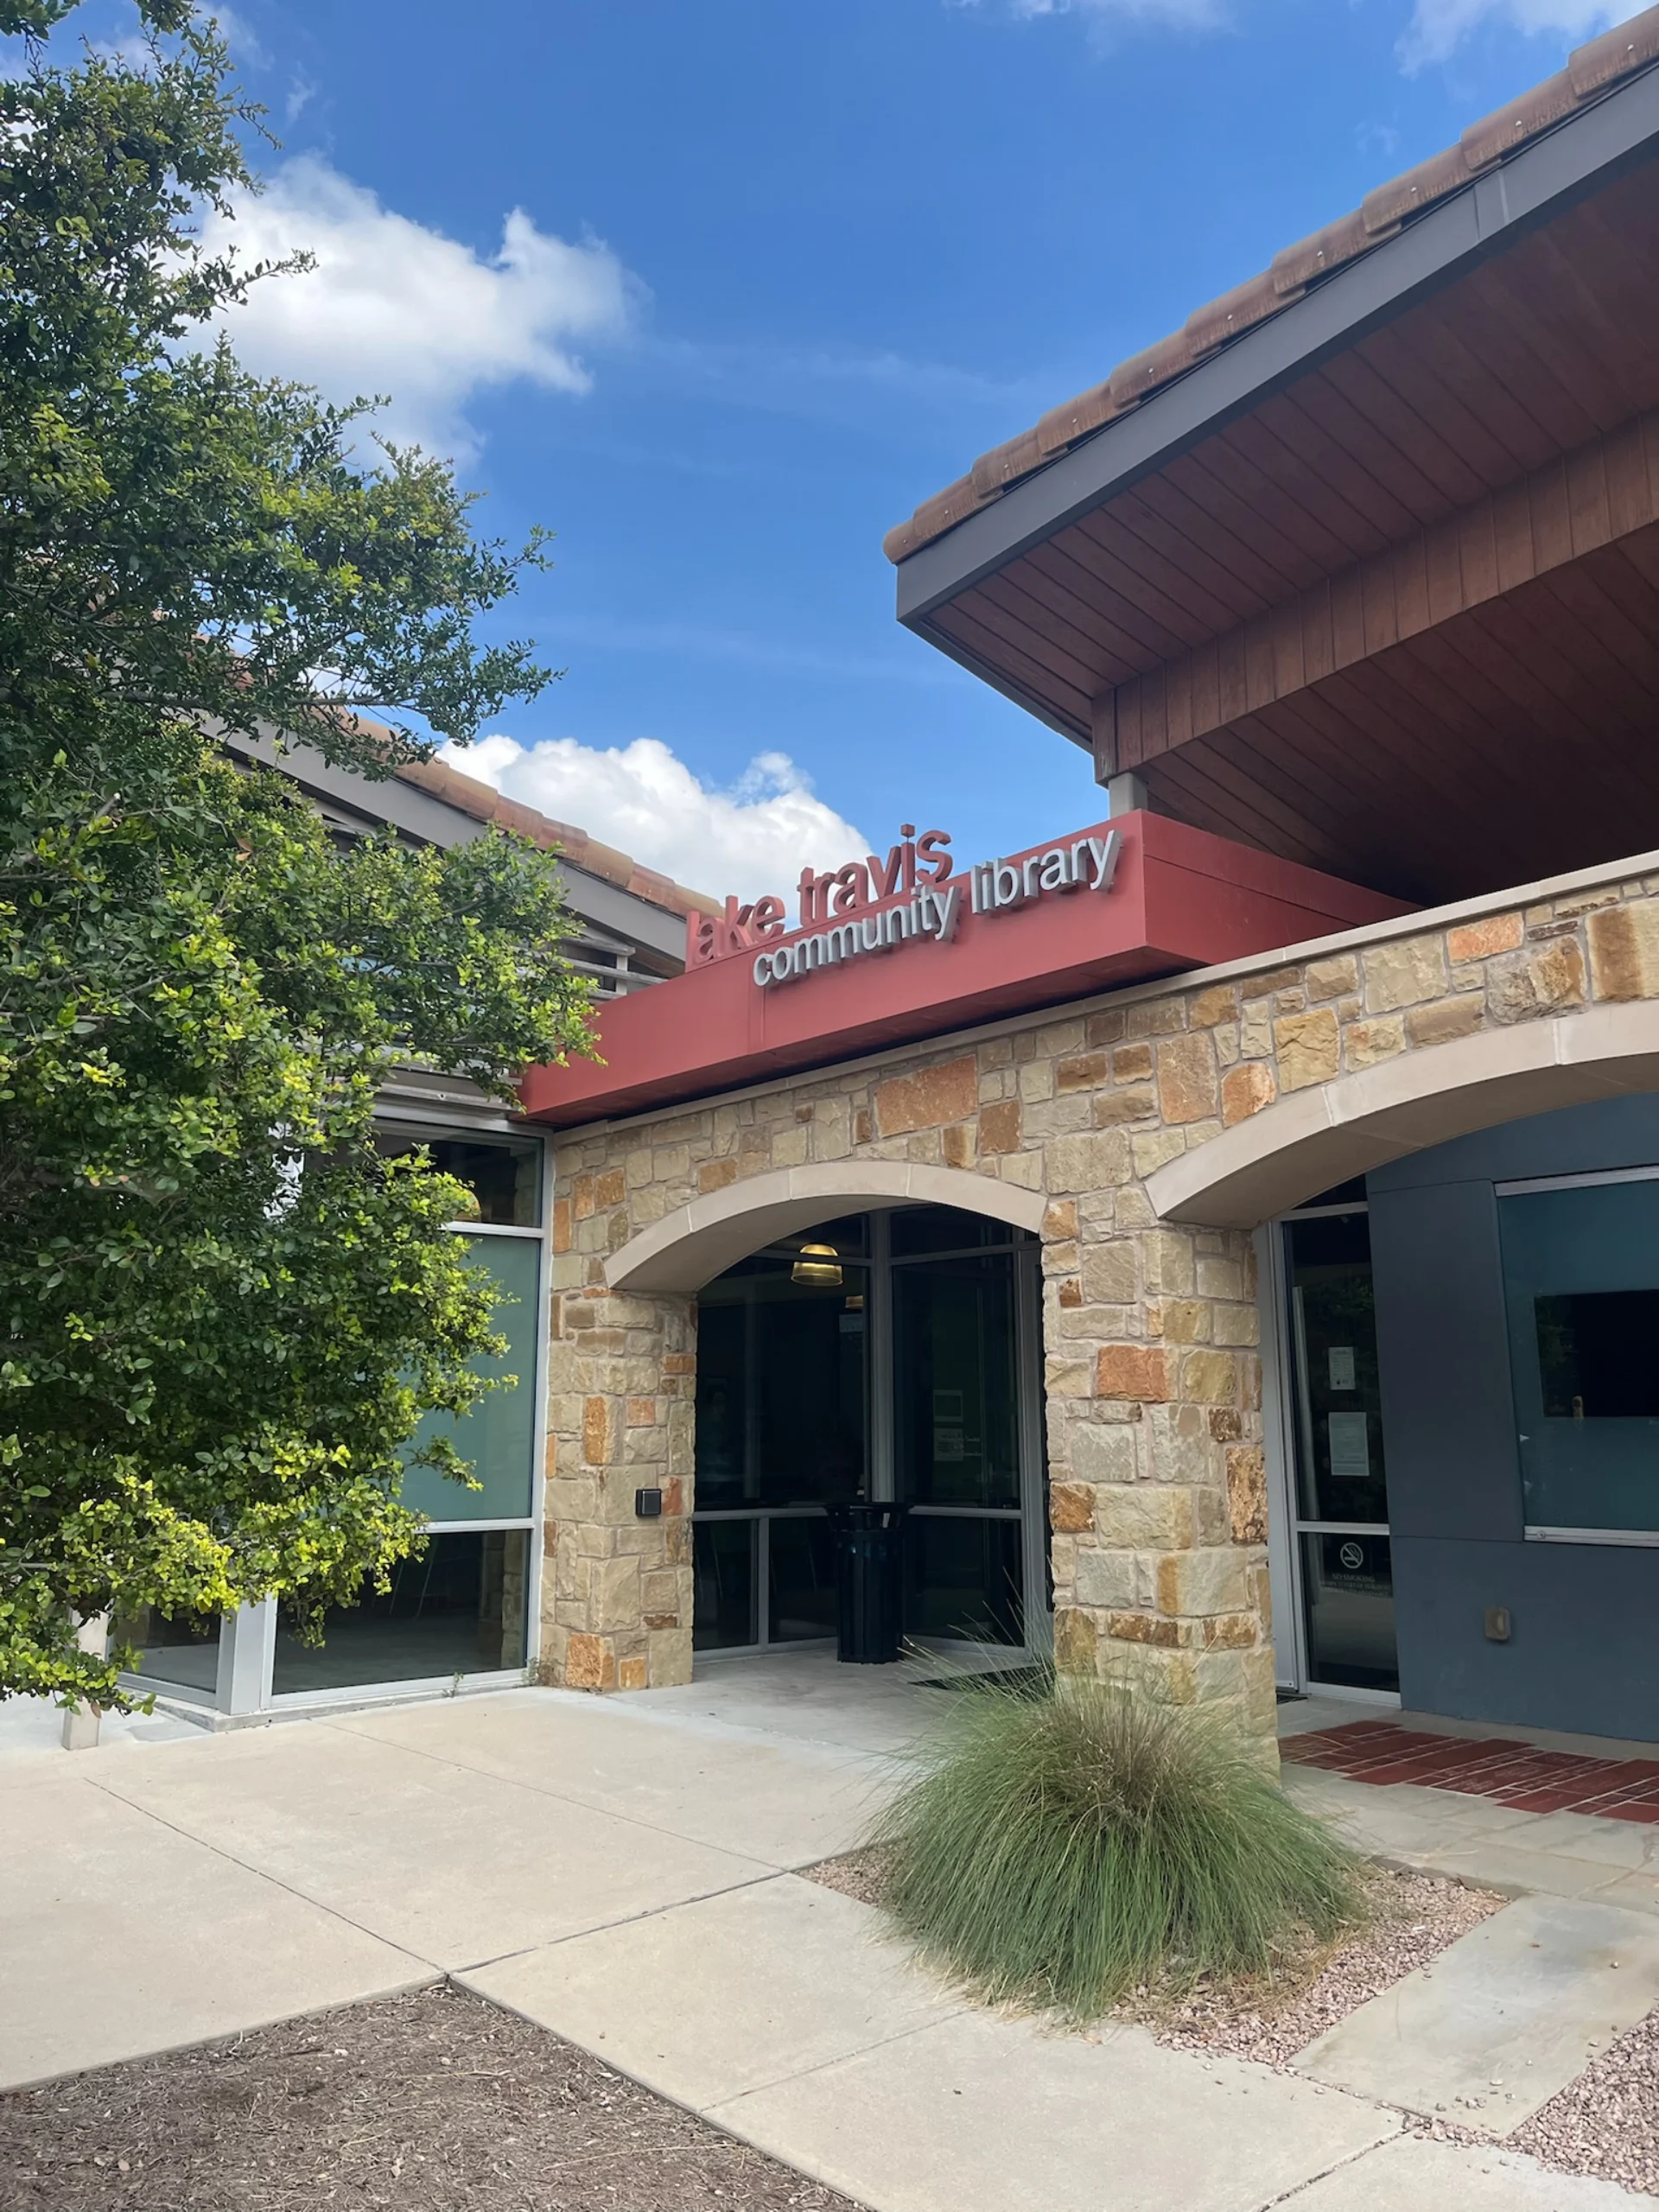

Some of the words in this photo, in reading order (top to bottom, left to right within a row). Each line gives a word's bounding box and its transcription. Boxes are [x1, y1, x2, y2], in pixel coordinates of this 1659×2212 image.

[686, 895, 785, 972] lake
[797, 823, 952, 925] travis
[753, 885, 961, 987] community
[970, 829, 1122, 916] library
[1344, 1573, 1376, 1583] SMOKING
